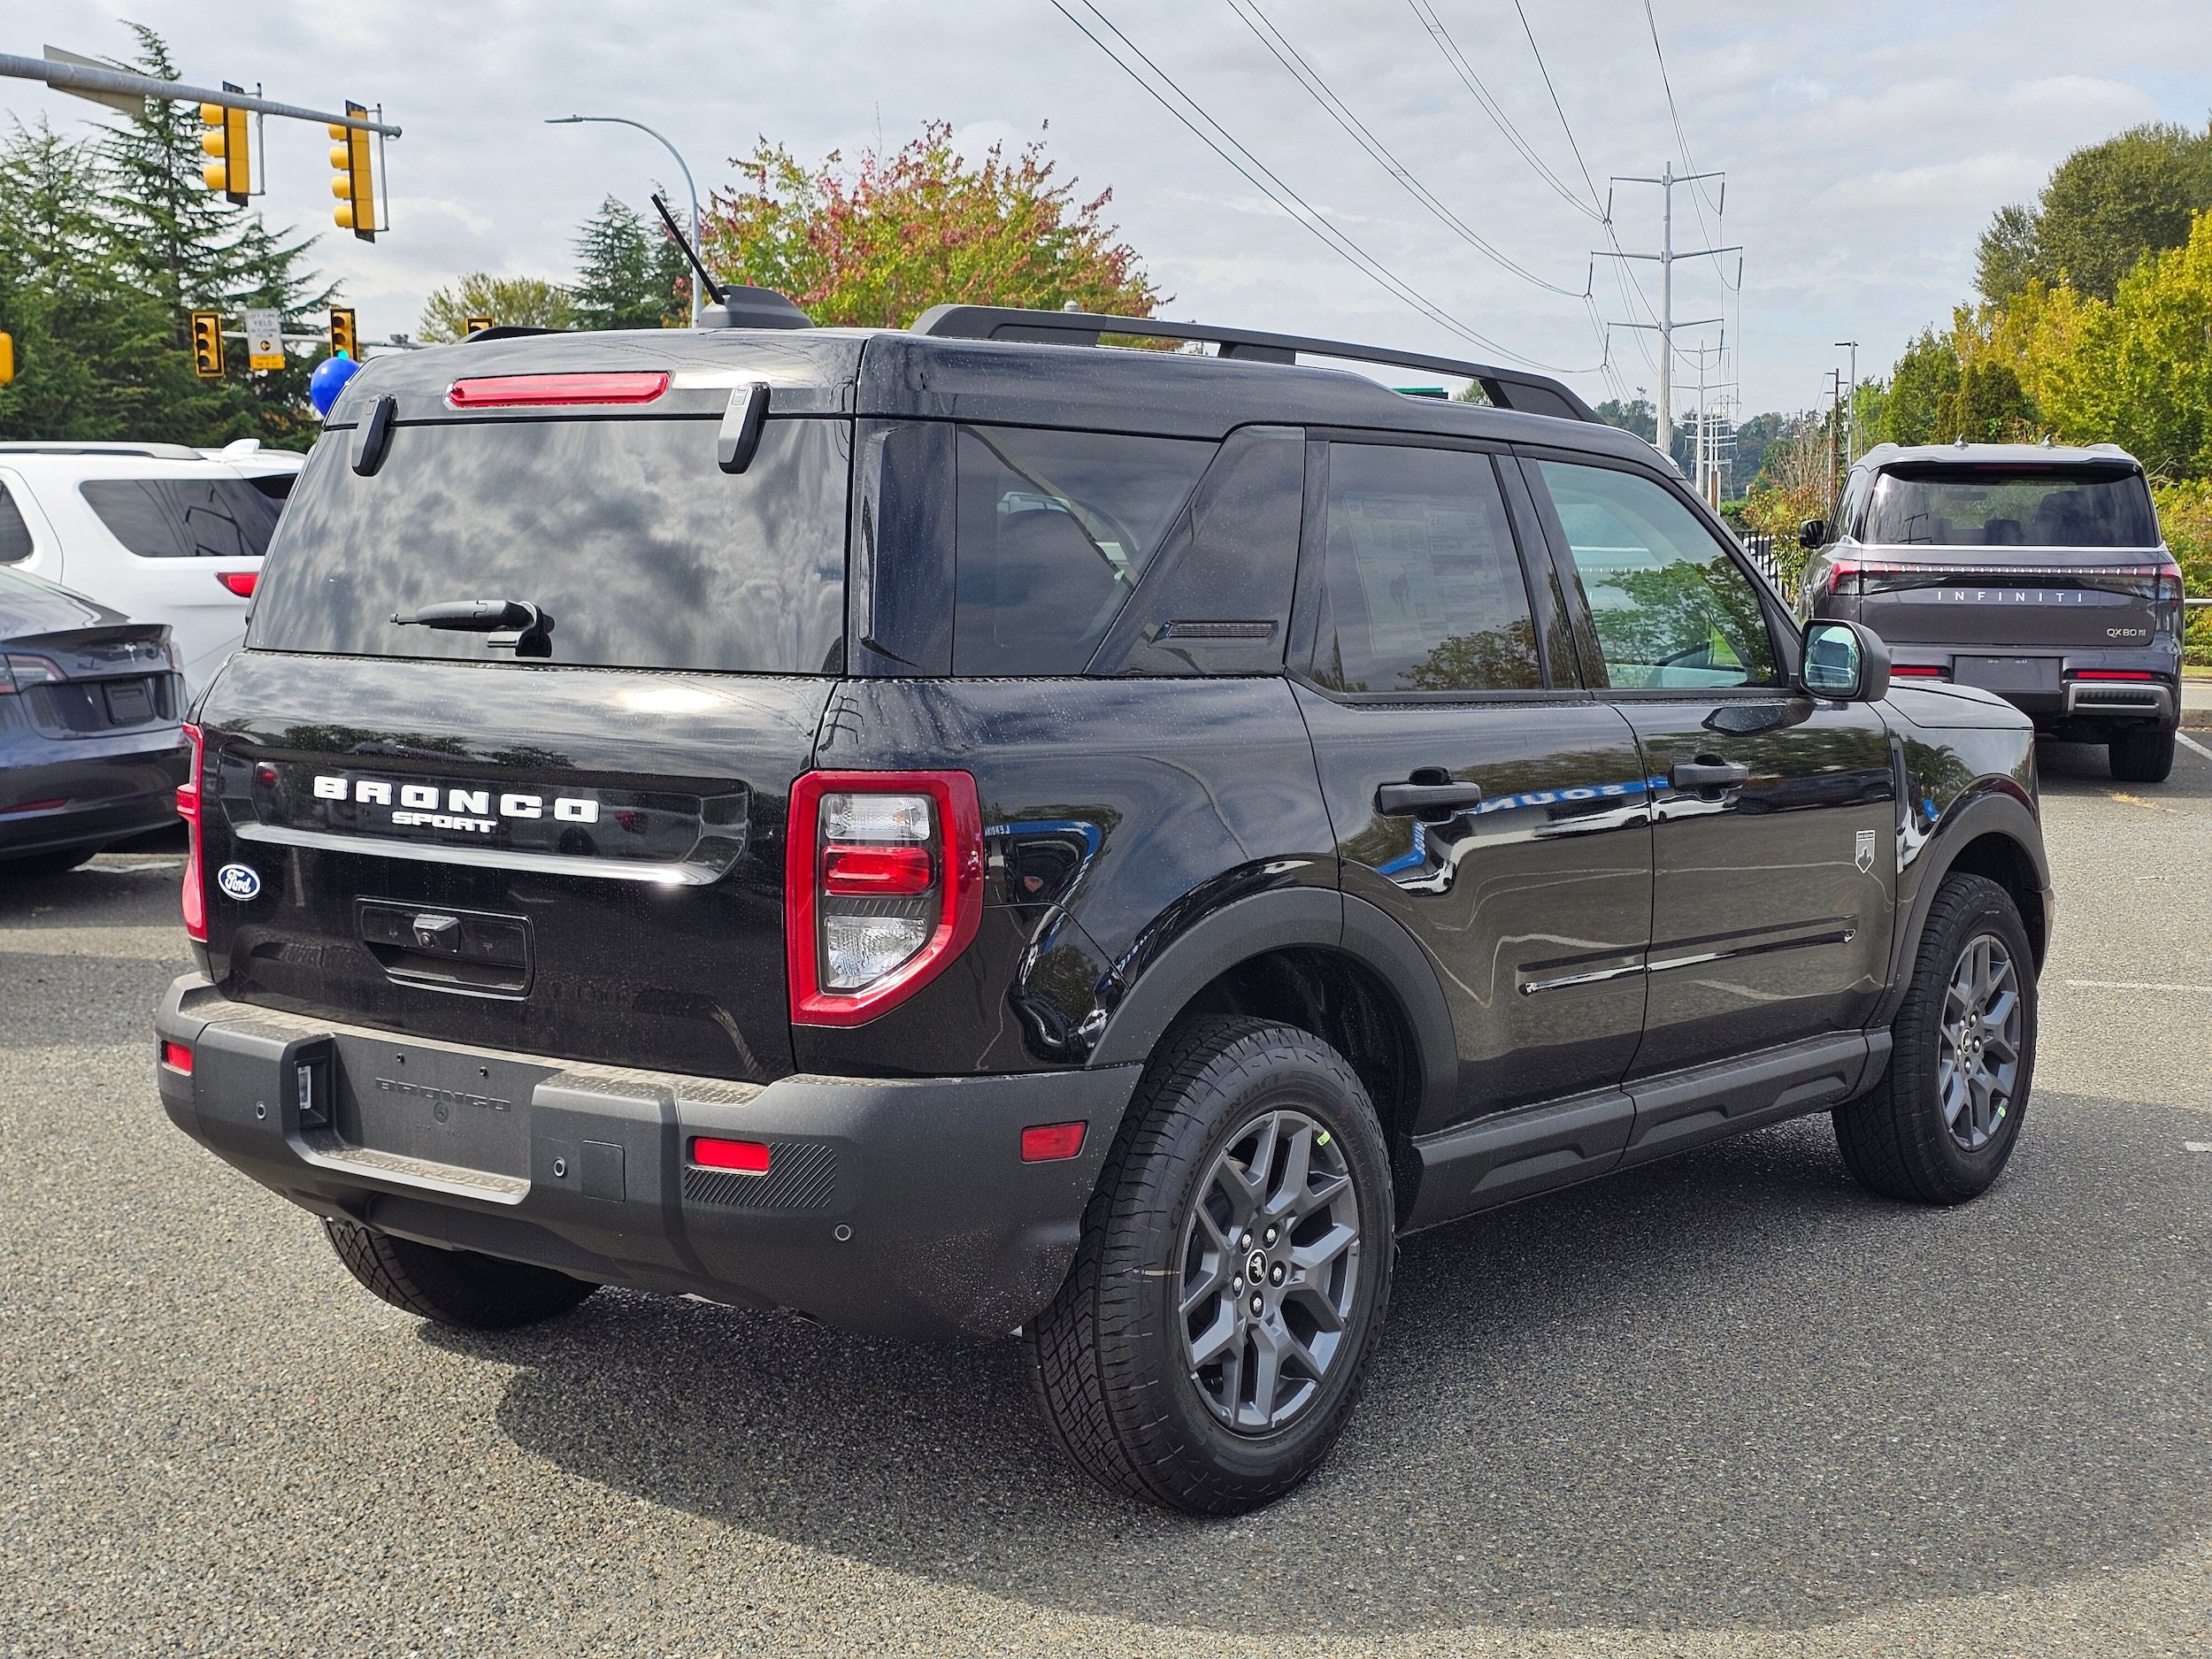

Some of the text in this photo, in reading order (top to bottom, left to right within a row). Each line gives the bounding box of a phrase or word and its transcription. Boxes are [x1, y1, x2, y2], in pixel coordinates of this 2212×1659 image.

[1938, 591, 2082, 603] INFINITI
[2107, 628, 2137, 638] QX80
[313, 775, 599, 824] BRONCO
[392, 810, 497, 833] SPORT
[225, 869, 251, 894] Ford
[375, 1077, 511, 1112] BRONCO
